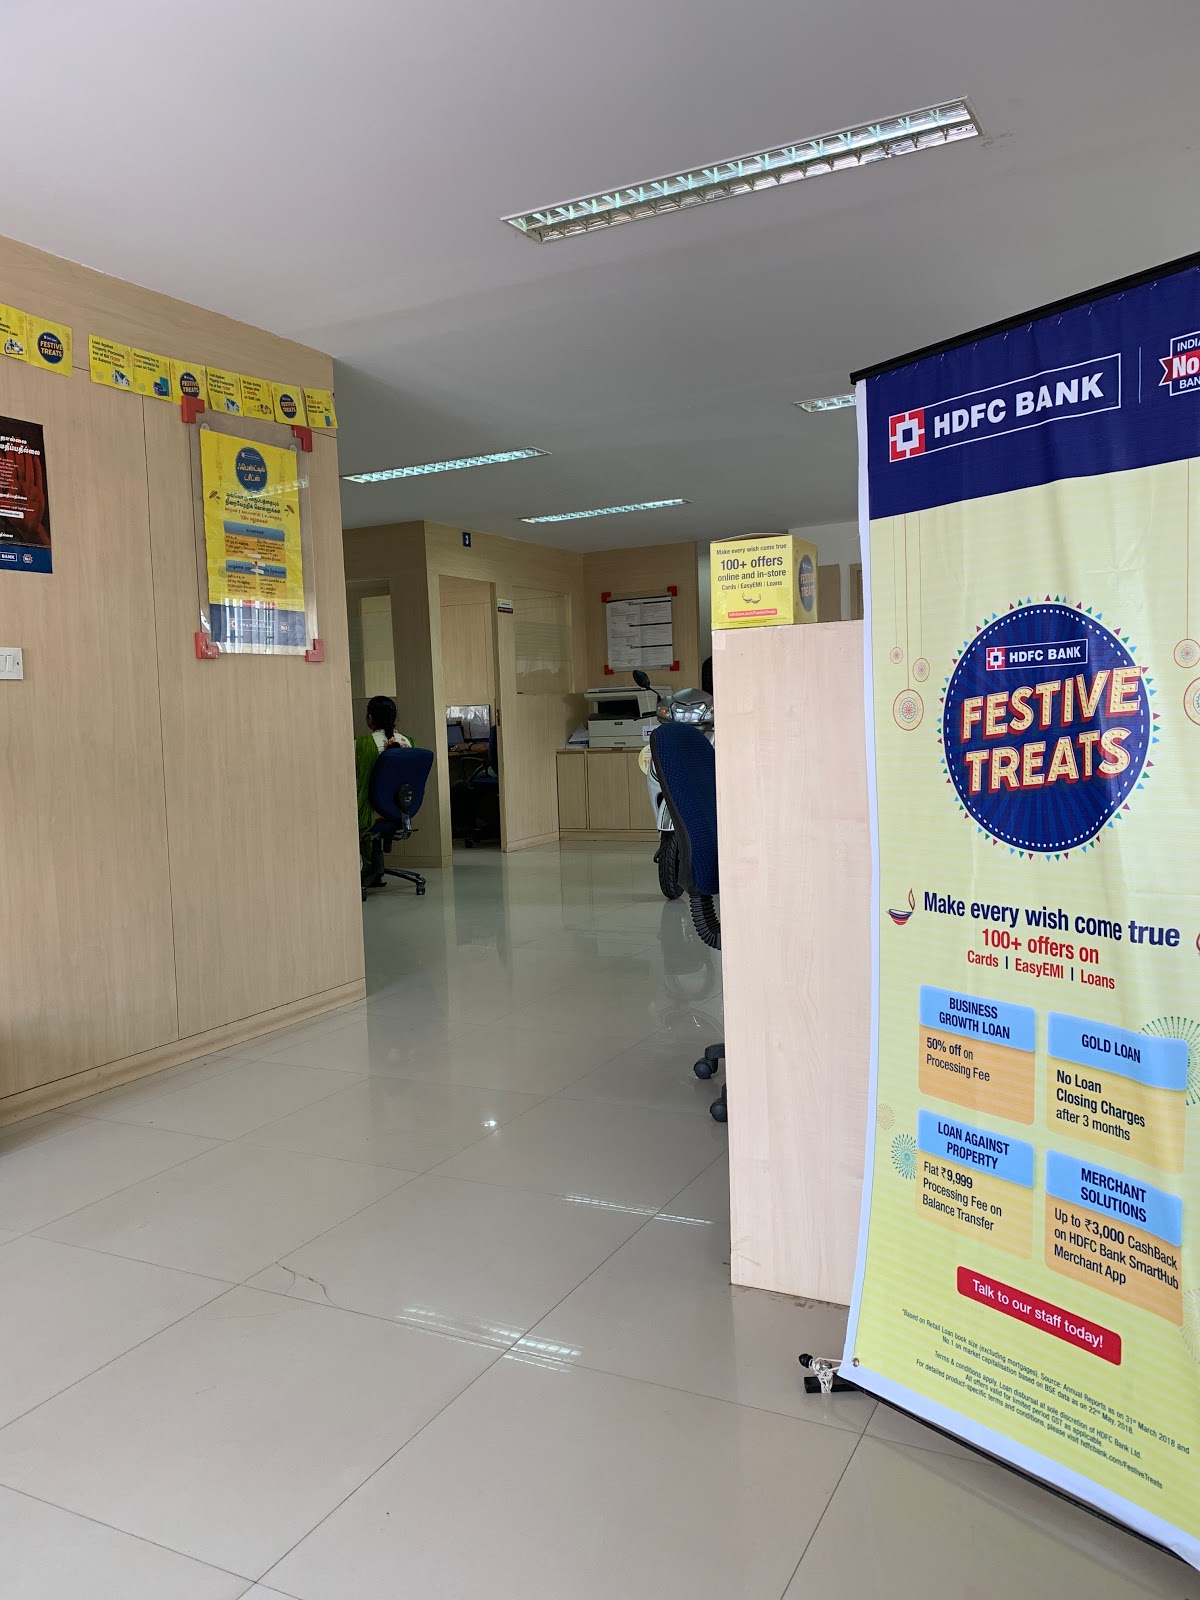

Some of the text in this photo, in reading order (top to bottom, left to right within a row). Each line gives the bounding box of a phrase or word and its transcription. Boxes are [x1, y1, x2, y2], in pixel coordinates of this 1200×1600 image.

[40, 341, 63, 350] FESTIVE
[41, 348, 62, 357] TREATS
[1178, 338, 1200, 351] INDI
[1180, 377, 1200, 389] BAN
[934, 372, 1104, 438] HDFC BANK
[718, 569, 786, 582] online and in-store
[721, 556, 783, 570] 100+ offers
[741, 582, 762, 590] EasyEMI
[1009, 646, 1081, 664] HDFC BANK
[960, 666, 1142, 743] FESTIVE
[964, 727, 1132, 796] TREATS
[924, 891, 1180, 947] Make every wish come true
[982, 928, 1100, 965] 100+ offers on
[967, 950, 1116, 990] Cards EasyEMI Loans
[949, 997, 998, 1019] BUSINESS
[939, 1012, 1010, 1040] GROWTH LOAN
[926, 1037, 973, 1060] 50% off on
[1081, 1034, 1141, 1064] GOLD LOAN
[926, 1054, 990, 1082] Processing Fee
[1056, 1069, 1102, 1094] No Loan
[1056, 1088, 1146, 1128] Closing Charges
[1056, 1108, 1131, 1141] after 3 months
[938, 1122, 1010, 1156] LOAN AGAINST
[947, 1142, 998, 1170] PROPERTY
[924, 1161, 973, 1189] Flat ₹9,999
[1081, 1168, 1147, 1203] MERCHANT
[922, 1194, 994, 1232] Balance Transfer
[923, 1178, 1002, 1217] Processing Fee on
[1080, 1187, 1147, 1223] SOLUTIONS
[1054, 1207, 1178, 1270] Up to ₹3,000 CashBack
[1054, 1228, 1179, 1290] on HDFC Bank SmartHub
[1054, 1244, 1127, 1286] Merchant App
[972, 1279, 1103, 1348] Talk to our staff today!
[925, 1364, 944, 1378] detailed
[988, 1394, 1003, 1406] terms
[1005, 1402, 1015, 1411] and
[927, 1320, 940, 1331] Retail
[942, 1326, 953, 1337] Loan
[955, 1333, 967, 1343] book
[968, 1340, 978, 1348] size
[1063, 1384, 1082, 1399] Annual
[1084, 1394, 1106, 1411] Reports
[1138, 1422, 1157, 1437] March
[1159, 1433, 1175, 1448] 2018
[1177, 1444, 1189, 1454] and
[963, 1346, 980, 1359] market
[1018, 1372, 1034, 1384] based
[1045, 1384, 1056, 1395] BSE
[1058, 1391, 1070, 1402] data
[935, 1350, 949, 1363] Terms
[956, 1361, 981, 1378] conditions
[1000, 1381, 1012, 1393] Loan
[1014, 1389, 1038, 1406] disbursal
[1047, 1405, 1058, 1415] sole
[1060, 1412, 1087, 1430] discretion
[1097, 1429, 1113, 1444] HDFC
[1114, 1438, 1129, 1453] Bank
[973, 1379, 988, 1390] offers
[990, 1386, 1002, 1397] valid
[1013, 1397, 1031, 1410] limited
[1032, 1407, 1049, 1420] period
[1051, 1415, 1062, 1426] GST
